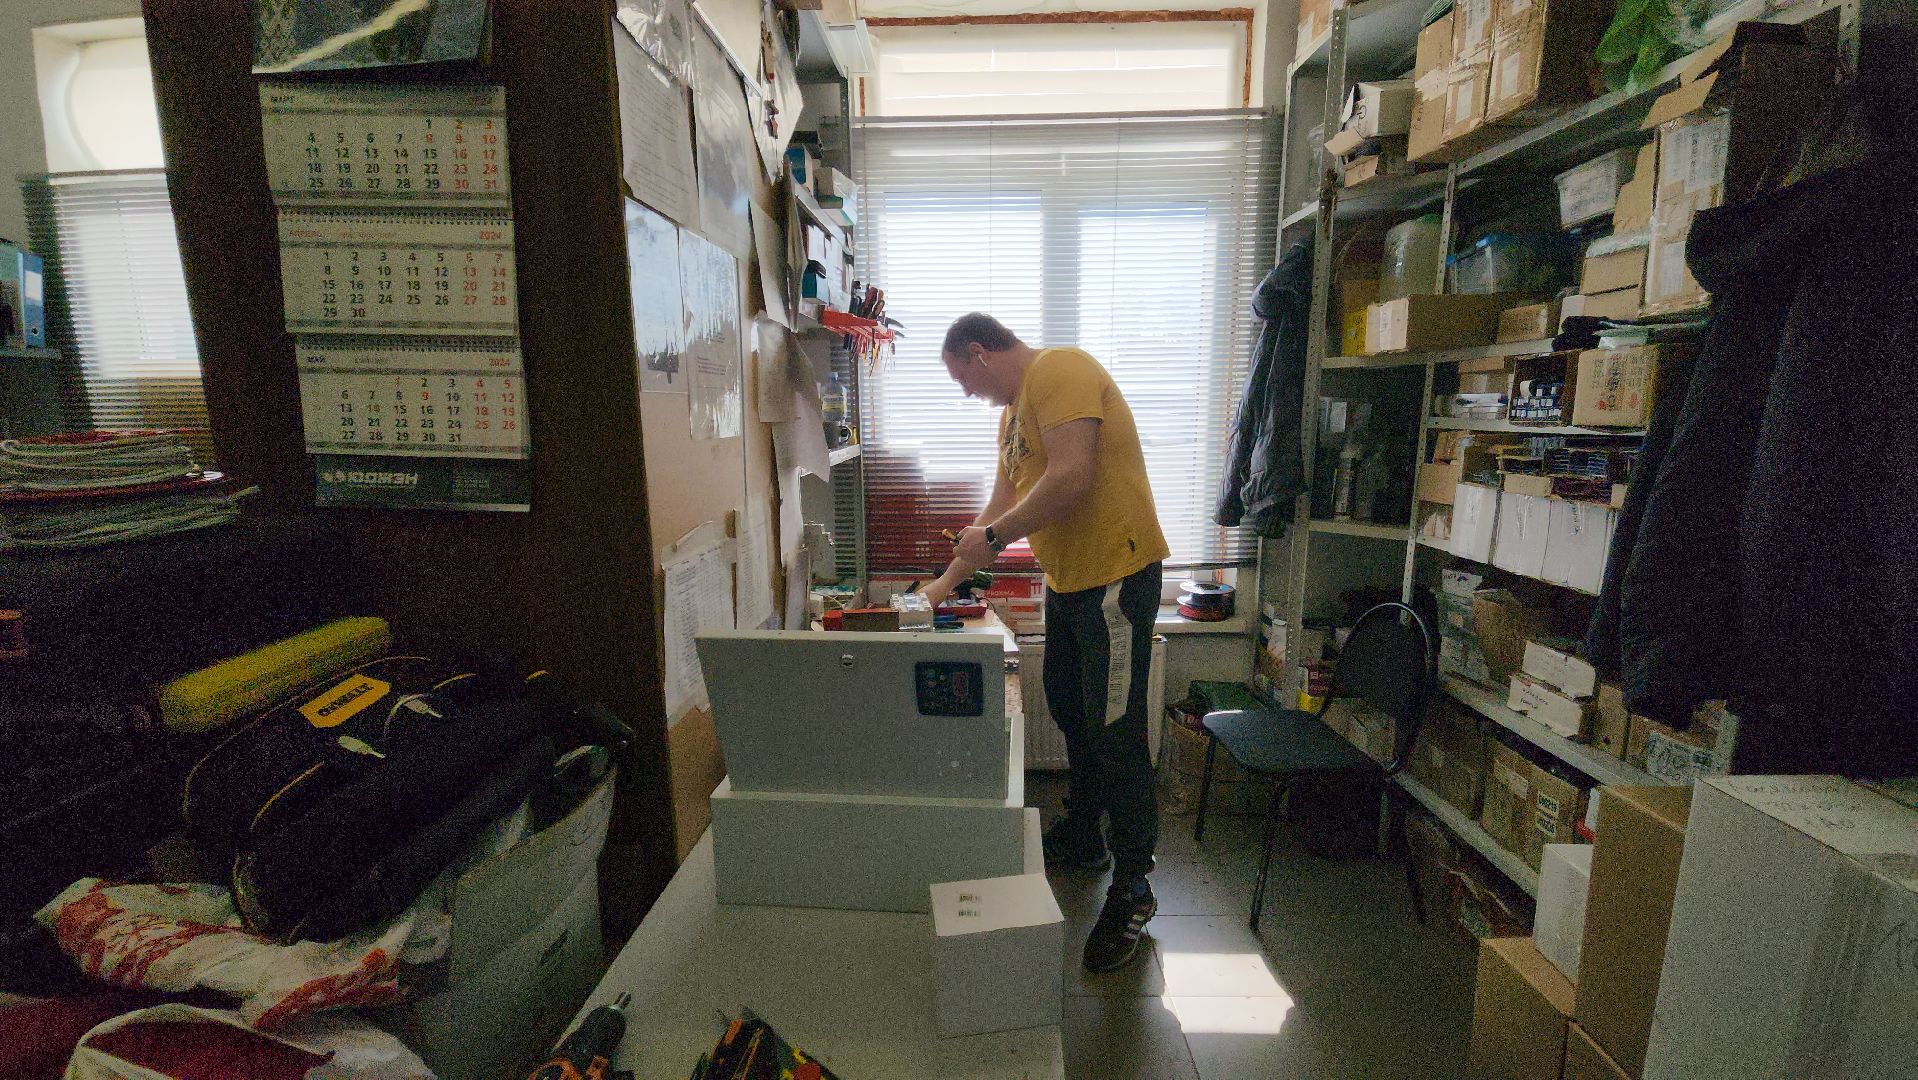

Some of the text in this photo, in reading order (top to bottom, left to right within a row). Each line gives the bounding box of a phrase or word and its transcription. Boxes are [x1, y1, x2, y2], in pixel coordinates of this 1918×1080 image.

[426, 119, 491, 129] 1 2 3
[308, 132, 497, 145] 4 5 6 7 8 9 10
[306, 148, 496, 160] 11 12 13 14 15 16 17
[308, 163, 498, 175] 18 19 20 21 22 23 24
[309, 177, 497, 190] 25 26 27 28 29 30 31
[324, 251, 503, 263] 1 2 3 4 5 6 7
[325, 265, 506, 277] 8 9 10 11 12 13 14
[322, 280, 505, 291] 15 16 17 18 19 20 21
[323, 293, 506, 306] 22 23 24 25 26 27 28
[324, 307, 365, 318] 29 30
[395, 375, 511, 388] 1 2 3 4 5
[341, 390, 514, 403] 6 7 8 9 10 11 12
[339, 404, 515, 417] 13 14 15 16 17 18 19
[341, 417, 515, 430] 20 21 22 23 24 25 26
[343, 431, 461, 442] 27 28 29 30 31
